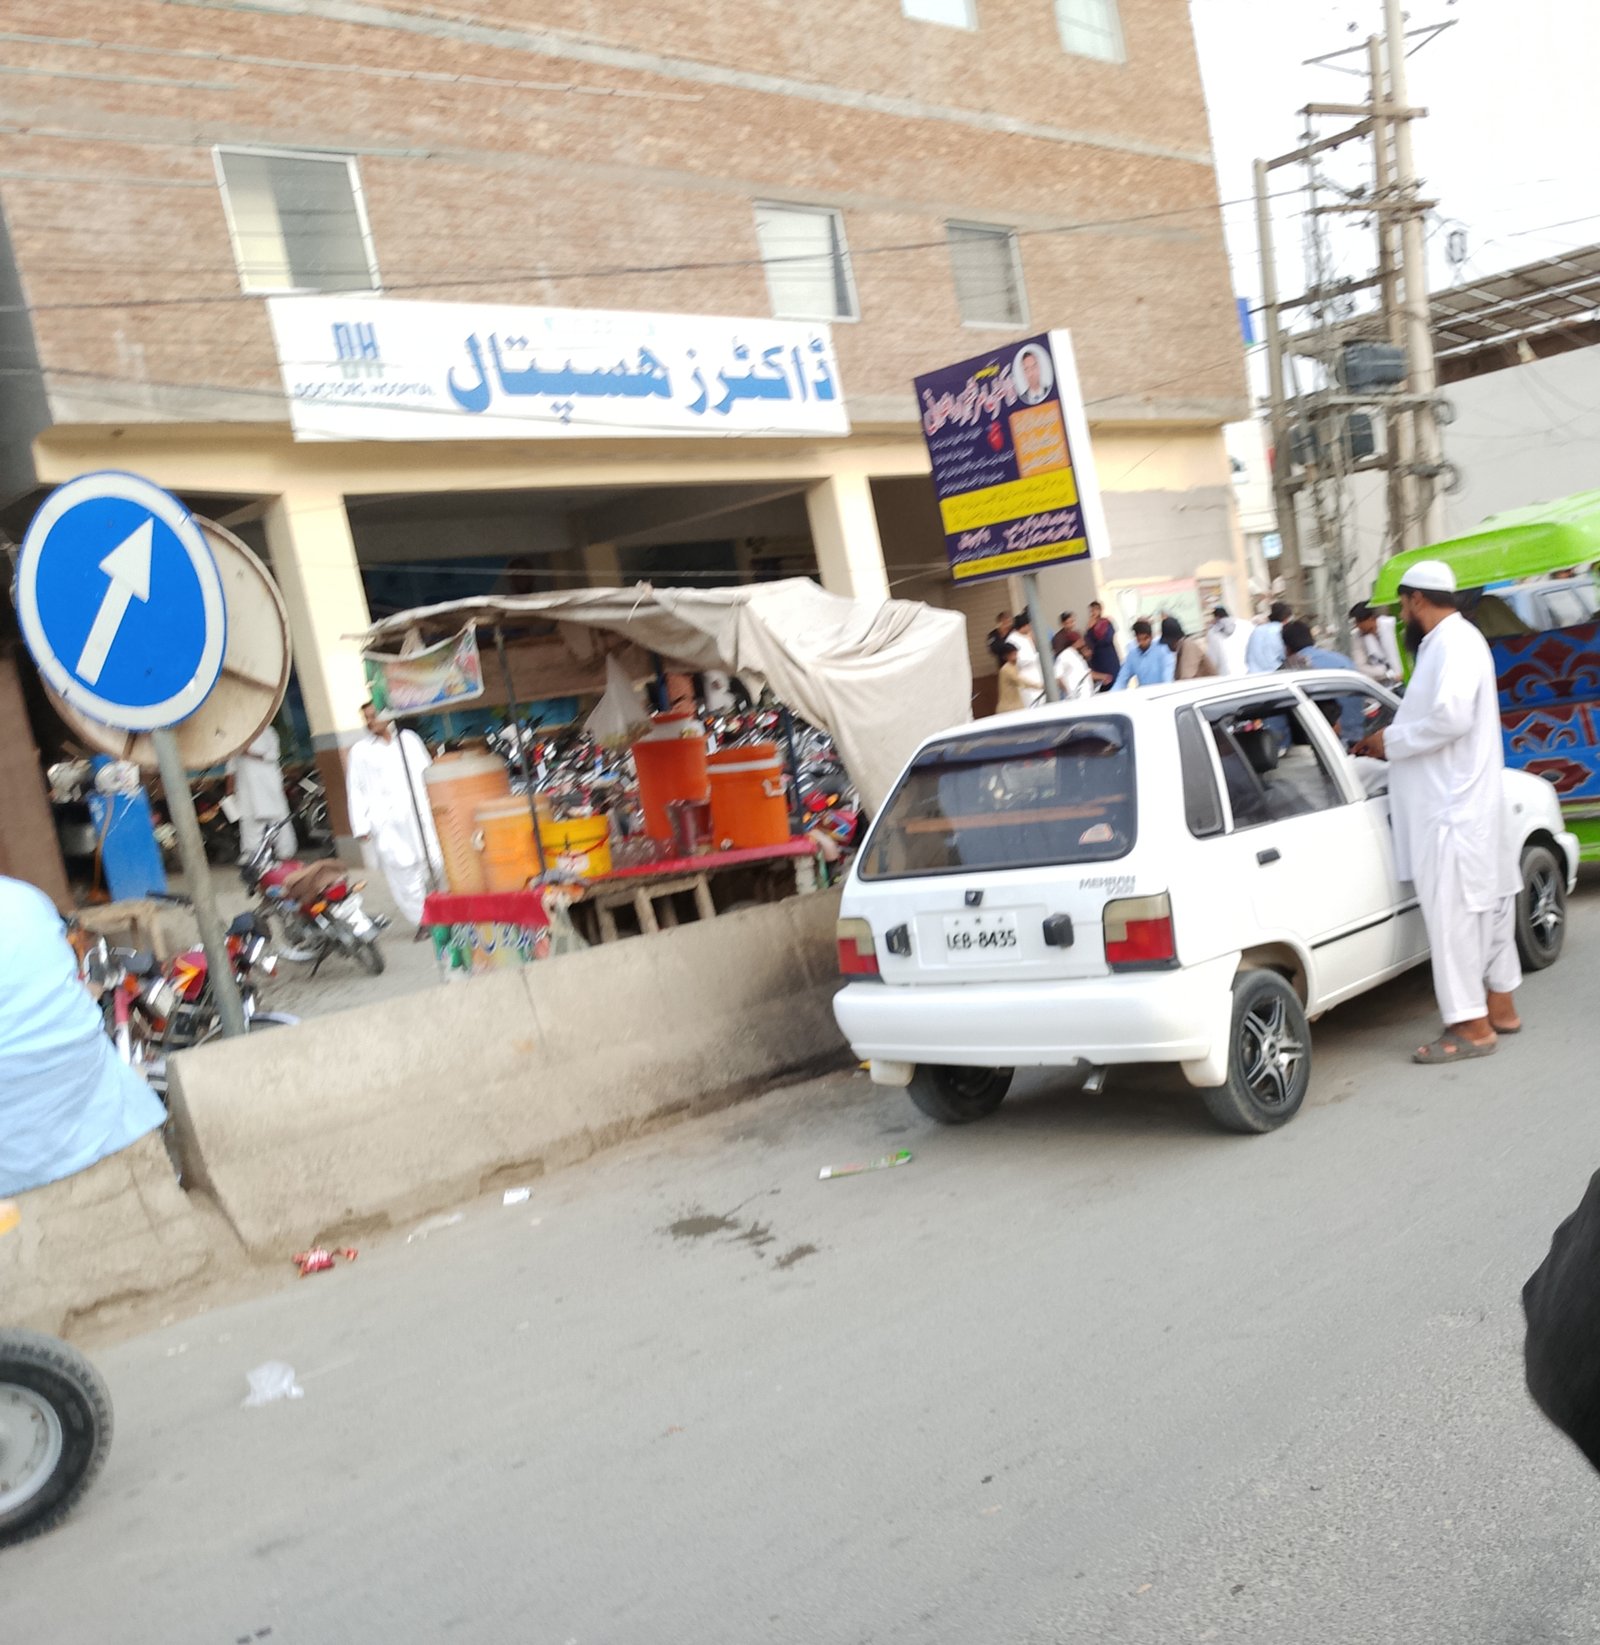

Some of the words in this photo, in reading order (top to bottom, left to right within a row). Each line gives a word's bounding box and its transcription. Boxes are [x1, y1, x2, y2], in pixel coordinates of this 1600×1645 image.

[685, 335, 837, 416] ڈاکٹرز
[1079, 875, 1136, 890] MEHRAN
[946, 929, 1017, 950] LEB-8435
